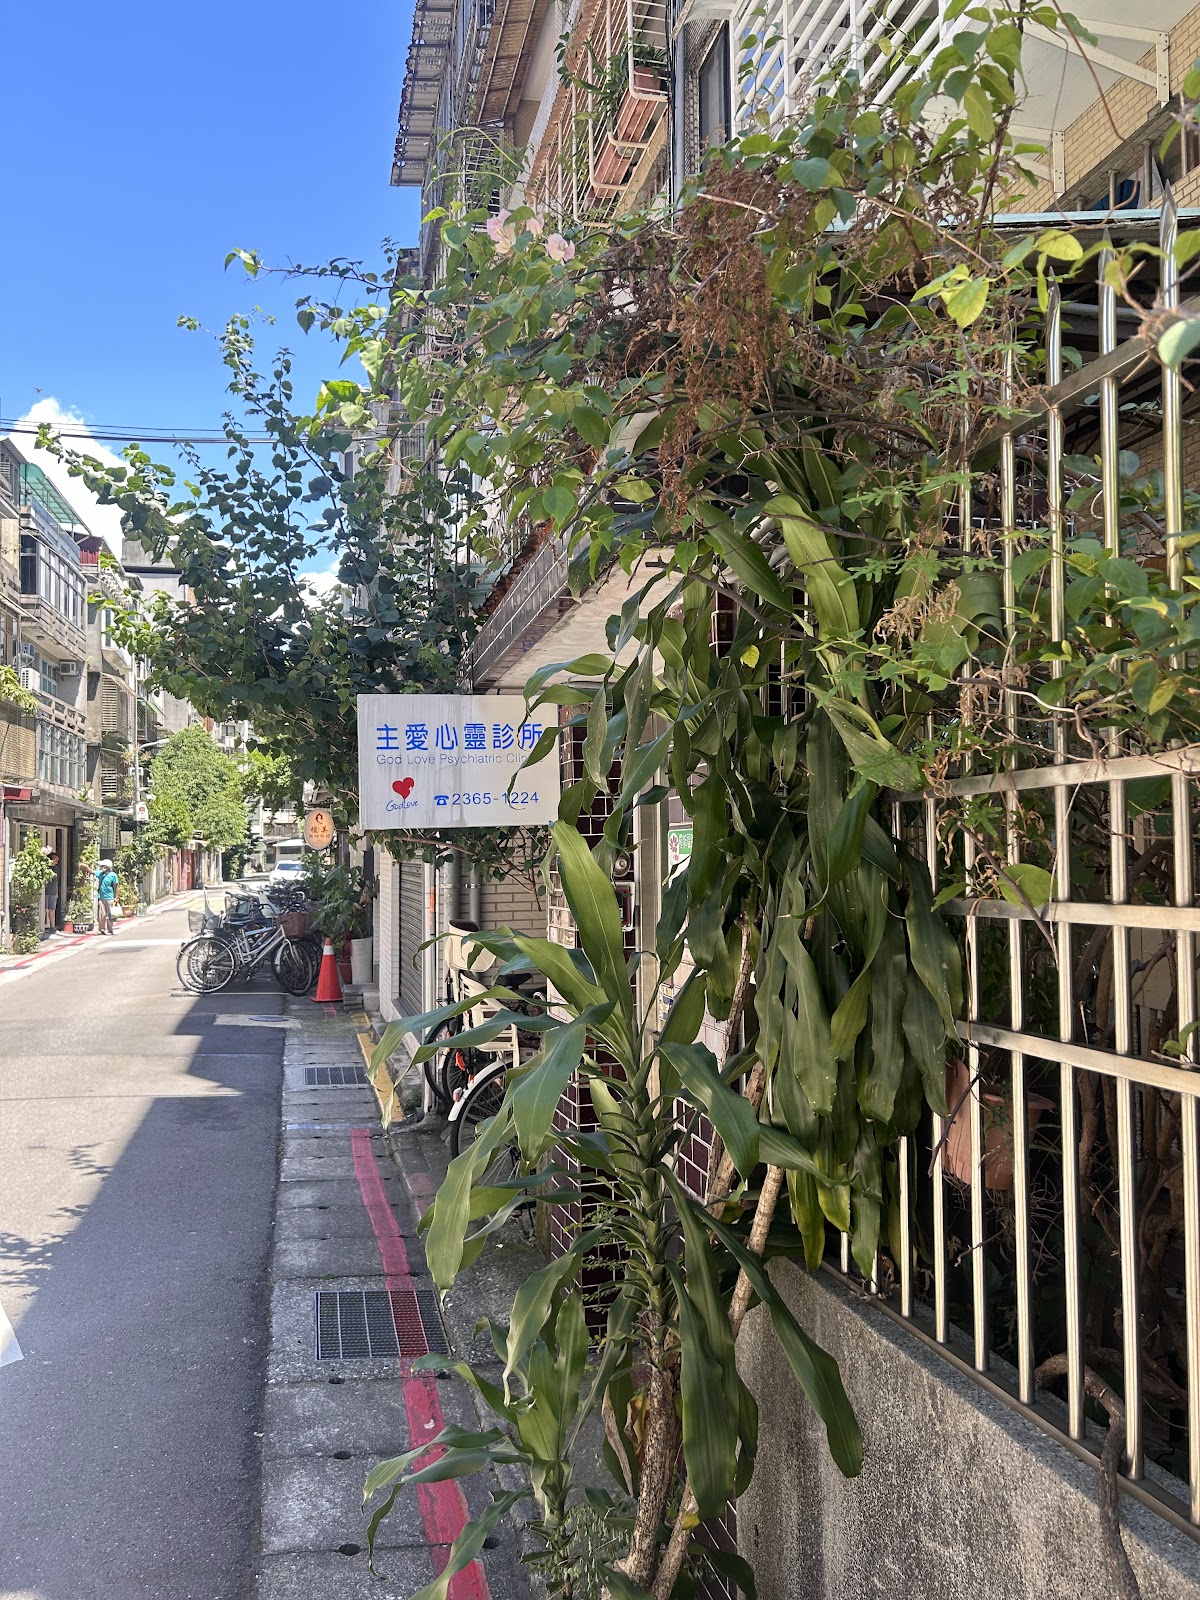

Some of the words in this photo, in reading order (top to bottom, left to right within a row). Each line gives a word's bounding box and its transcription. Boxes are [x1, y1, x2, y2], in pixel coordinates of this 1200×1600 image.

[376, 723, 543, 750] 主愛心靈診所
[376, 753, 402, 765] God
[407, 753, 436, 765] Love
[440, 752, 502, 767] Psychiatric
[506, 752, 544, 764] Clin
[452, 791, 539, 805] 2365-1224
